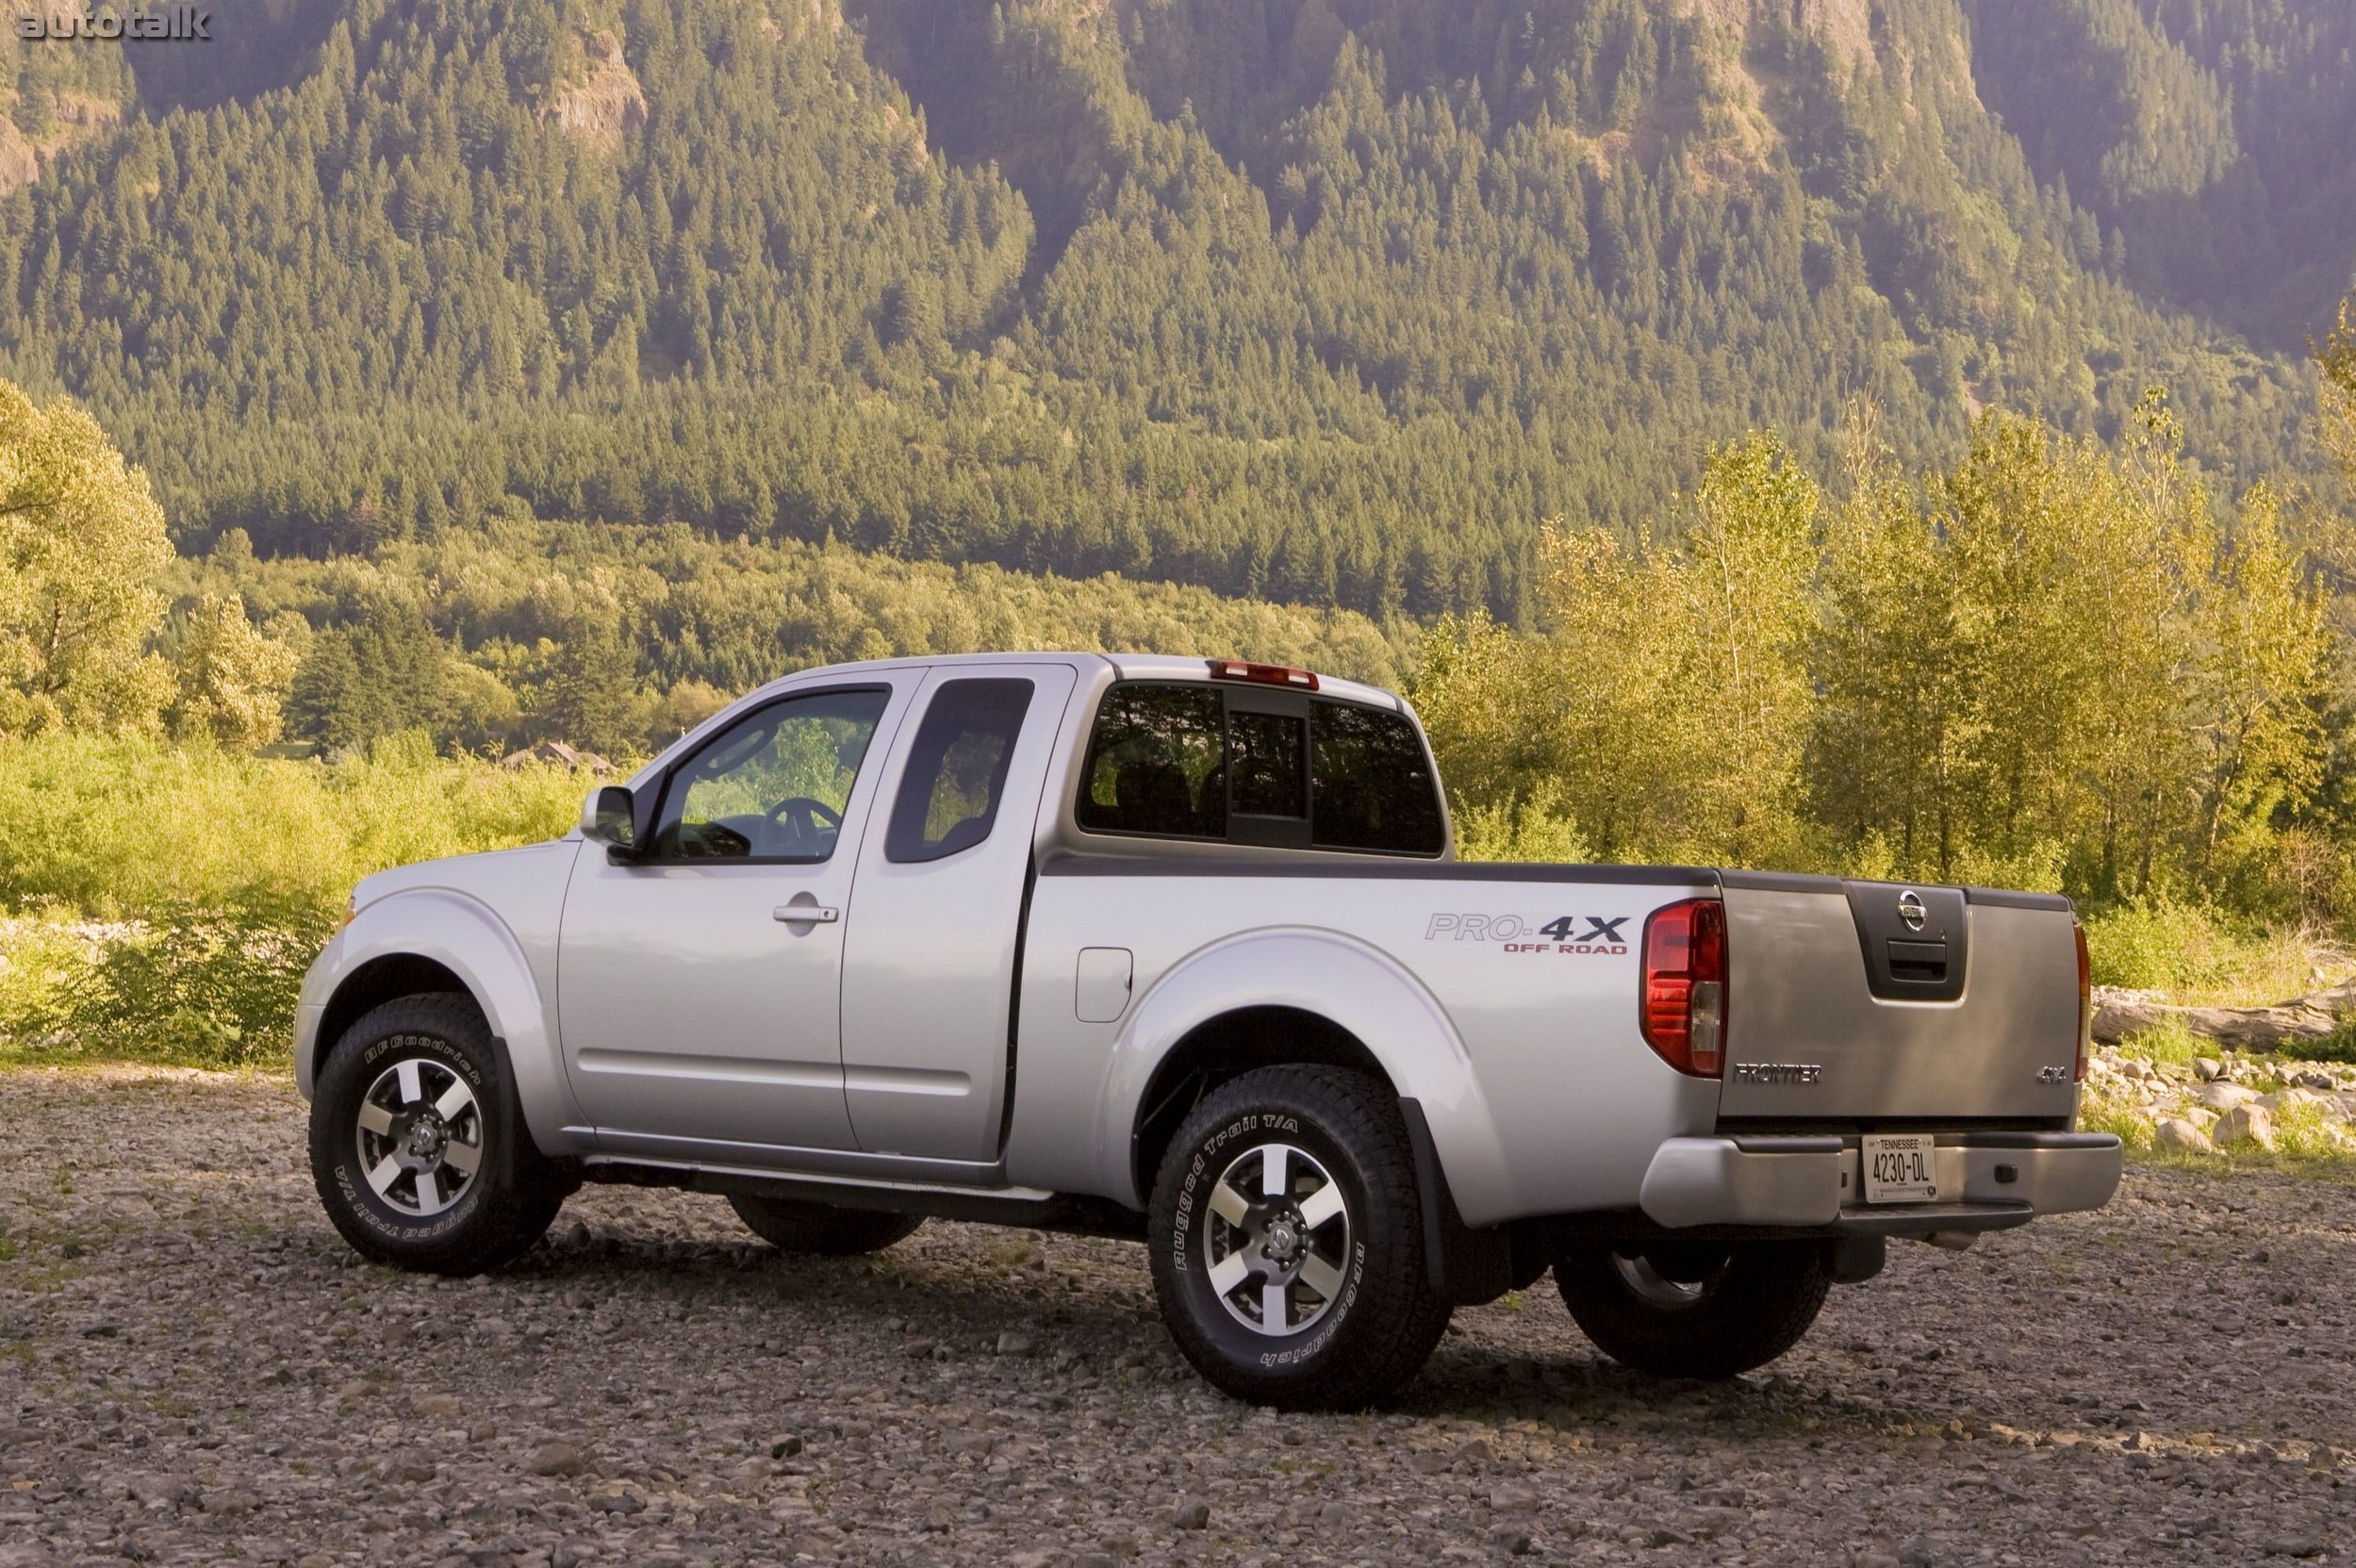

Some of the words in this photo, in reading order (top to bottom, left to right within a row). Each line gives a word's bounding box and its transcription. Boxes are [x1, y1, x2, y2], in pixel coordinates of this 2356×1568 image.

[1504, 944, 1550, 953] OFF
[1558, 945, 1627, 955] ROAD
[1735, 1063, 1821, 1083] FRONTIER
[1880, 1138, 1919, 1150] TENNESSEE
[1873, 1152, 1929, 1183] 4230-DL
[1173, 1153, 1205, 1271] Rugged
[1204, 1115, 1257, 1156] Trail
[1262, 1114, 1299, 1133] T/A
[353, 1202, 400, 1237] Trail
